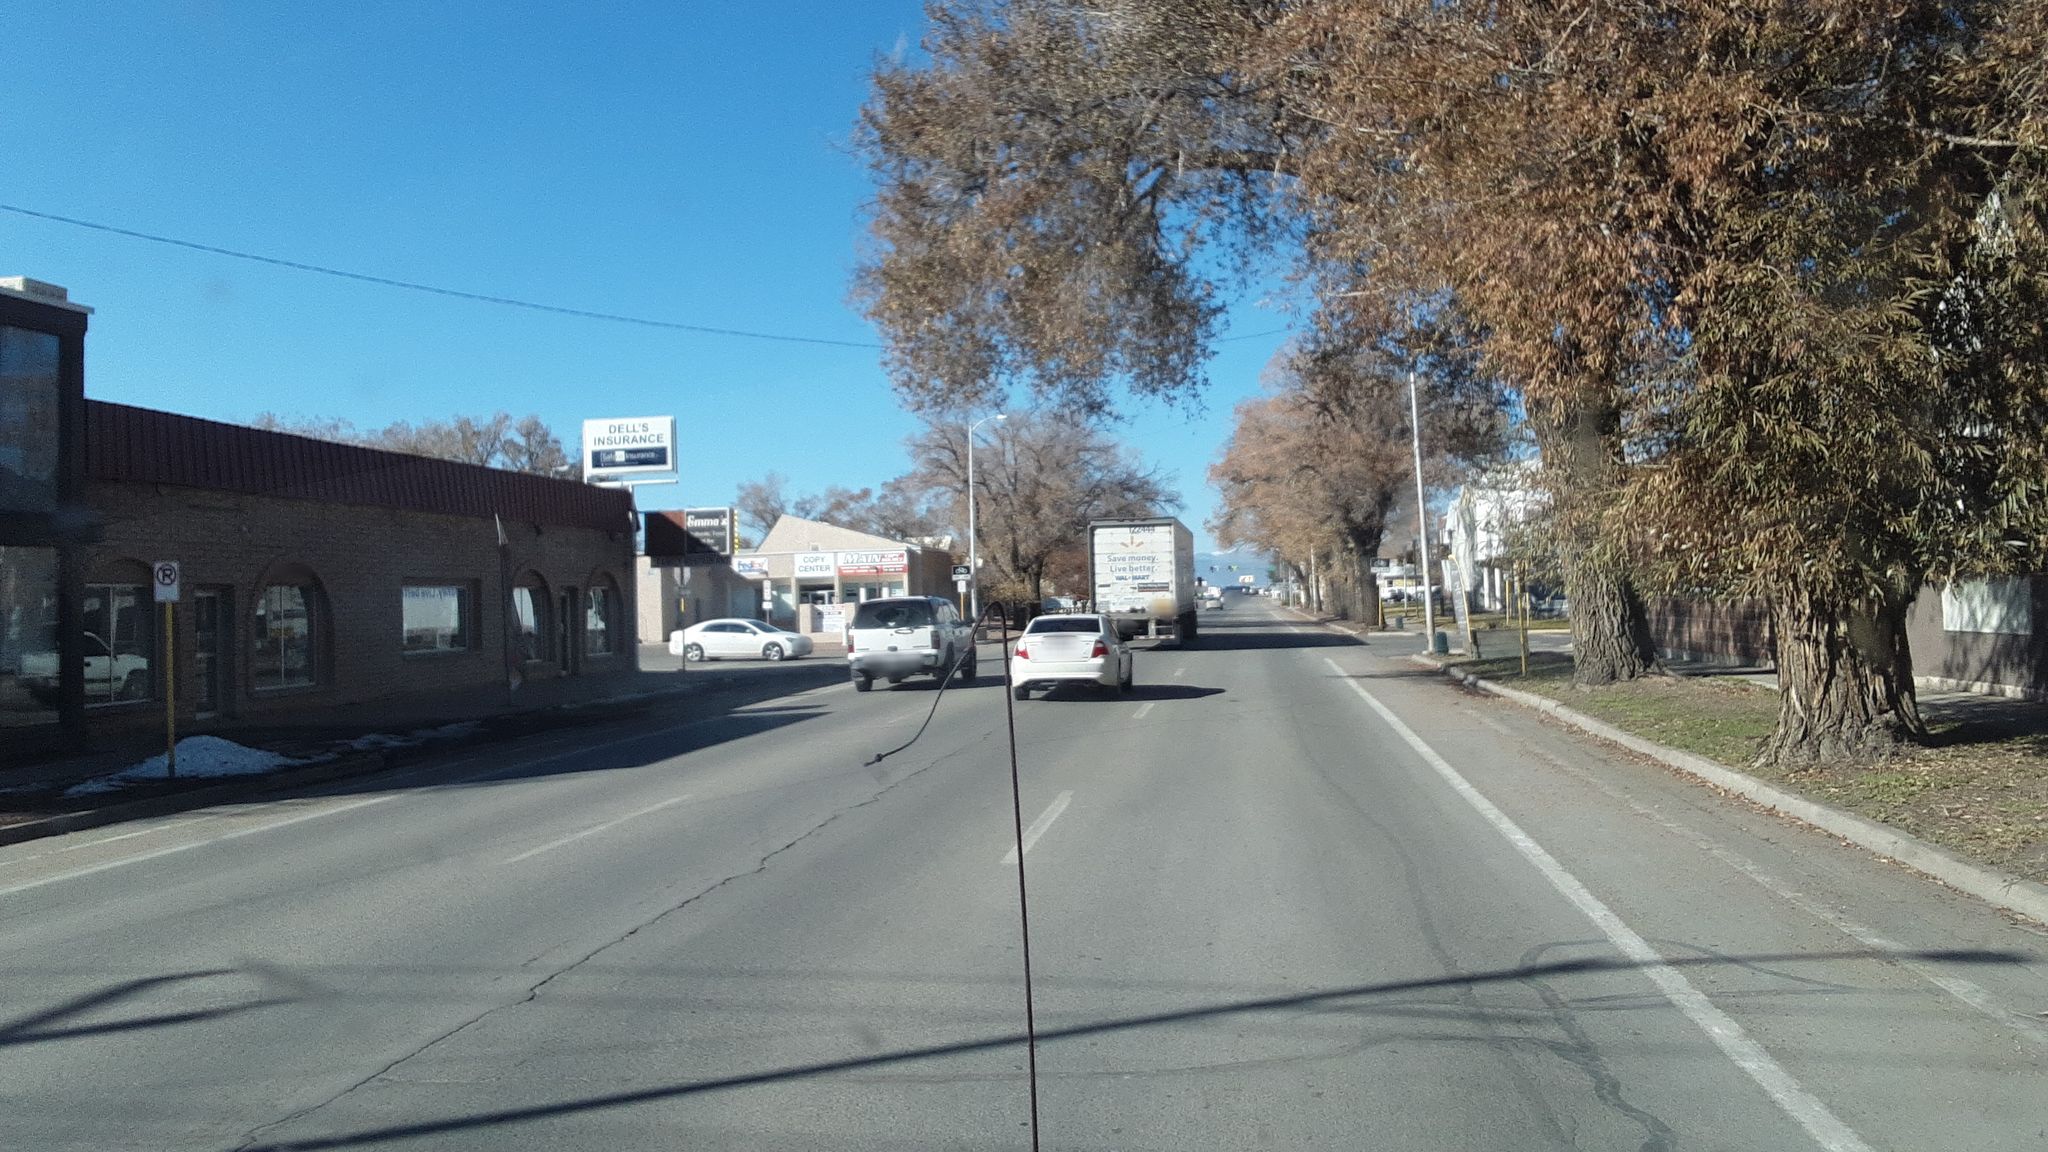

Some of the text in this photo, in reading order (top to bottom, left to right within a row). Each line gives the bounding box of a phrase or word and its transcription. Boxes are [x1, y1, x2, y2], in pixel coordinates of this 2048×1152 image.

[608, 423, 649, 434] DELL'S
[593, 433, 665, 446] INSURANCE
[1128, 554, 1159, 564] money.
[798, 564, 831, 572] CENTER
[1110, 565, 1127, 573] Live
